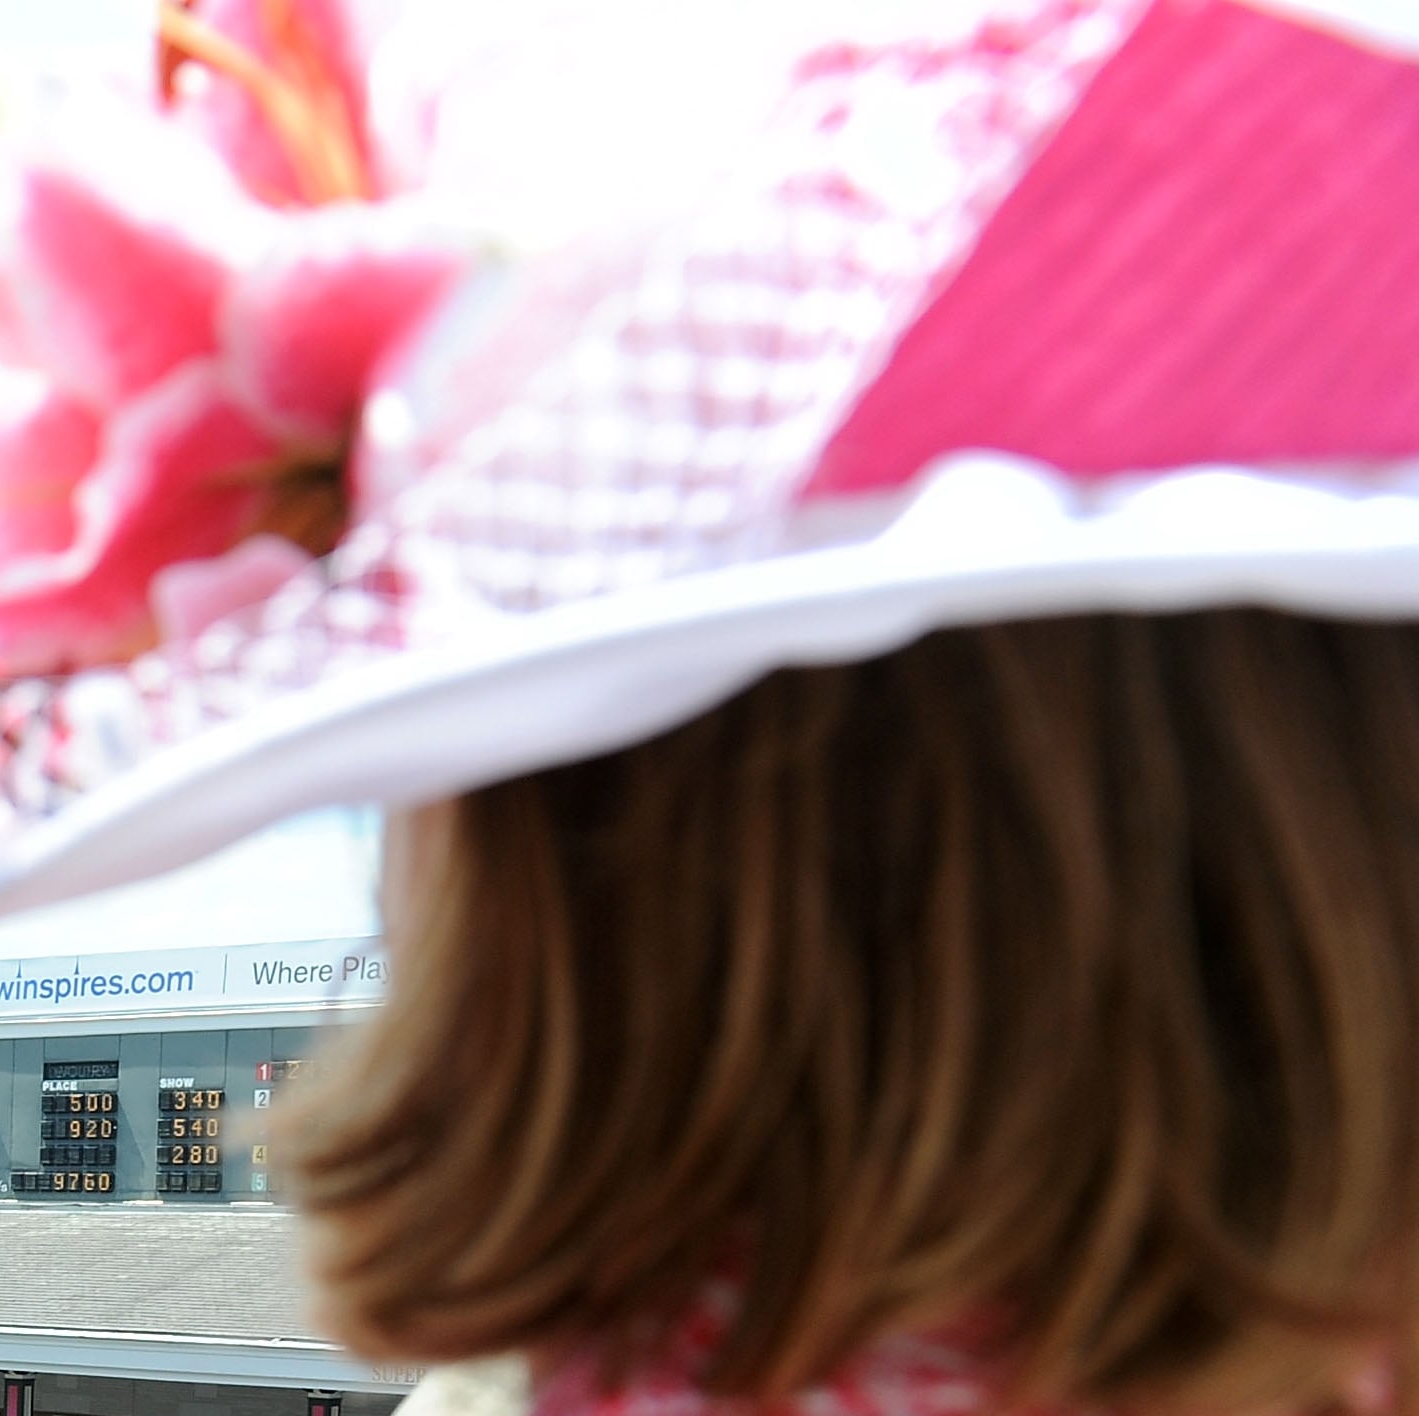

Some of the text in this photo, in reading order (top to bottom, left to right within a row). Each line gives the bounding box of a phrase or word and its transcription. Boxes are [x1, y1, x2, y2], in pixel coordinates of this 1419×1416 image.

[253, 961, 333, 985] Where
[43, 1081, 78, 1092] PLACE
[159, 1078, 195, 1088] SHOW
[70, 1094, 113, 1112] 500
[174, 1091, 220, 1111] 340
[258, 1091, 267, 1107] 2
[70, 1119, 112, 1139] 920
[173, 1118, 219, 1137] 540
[172, 1145, 218, 1165] 280
[53, 1172, 111, 1191] 9760
